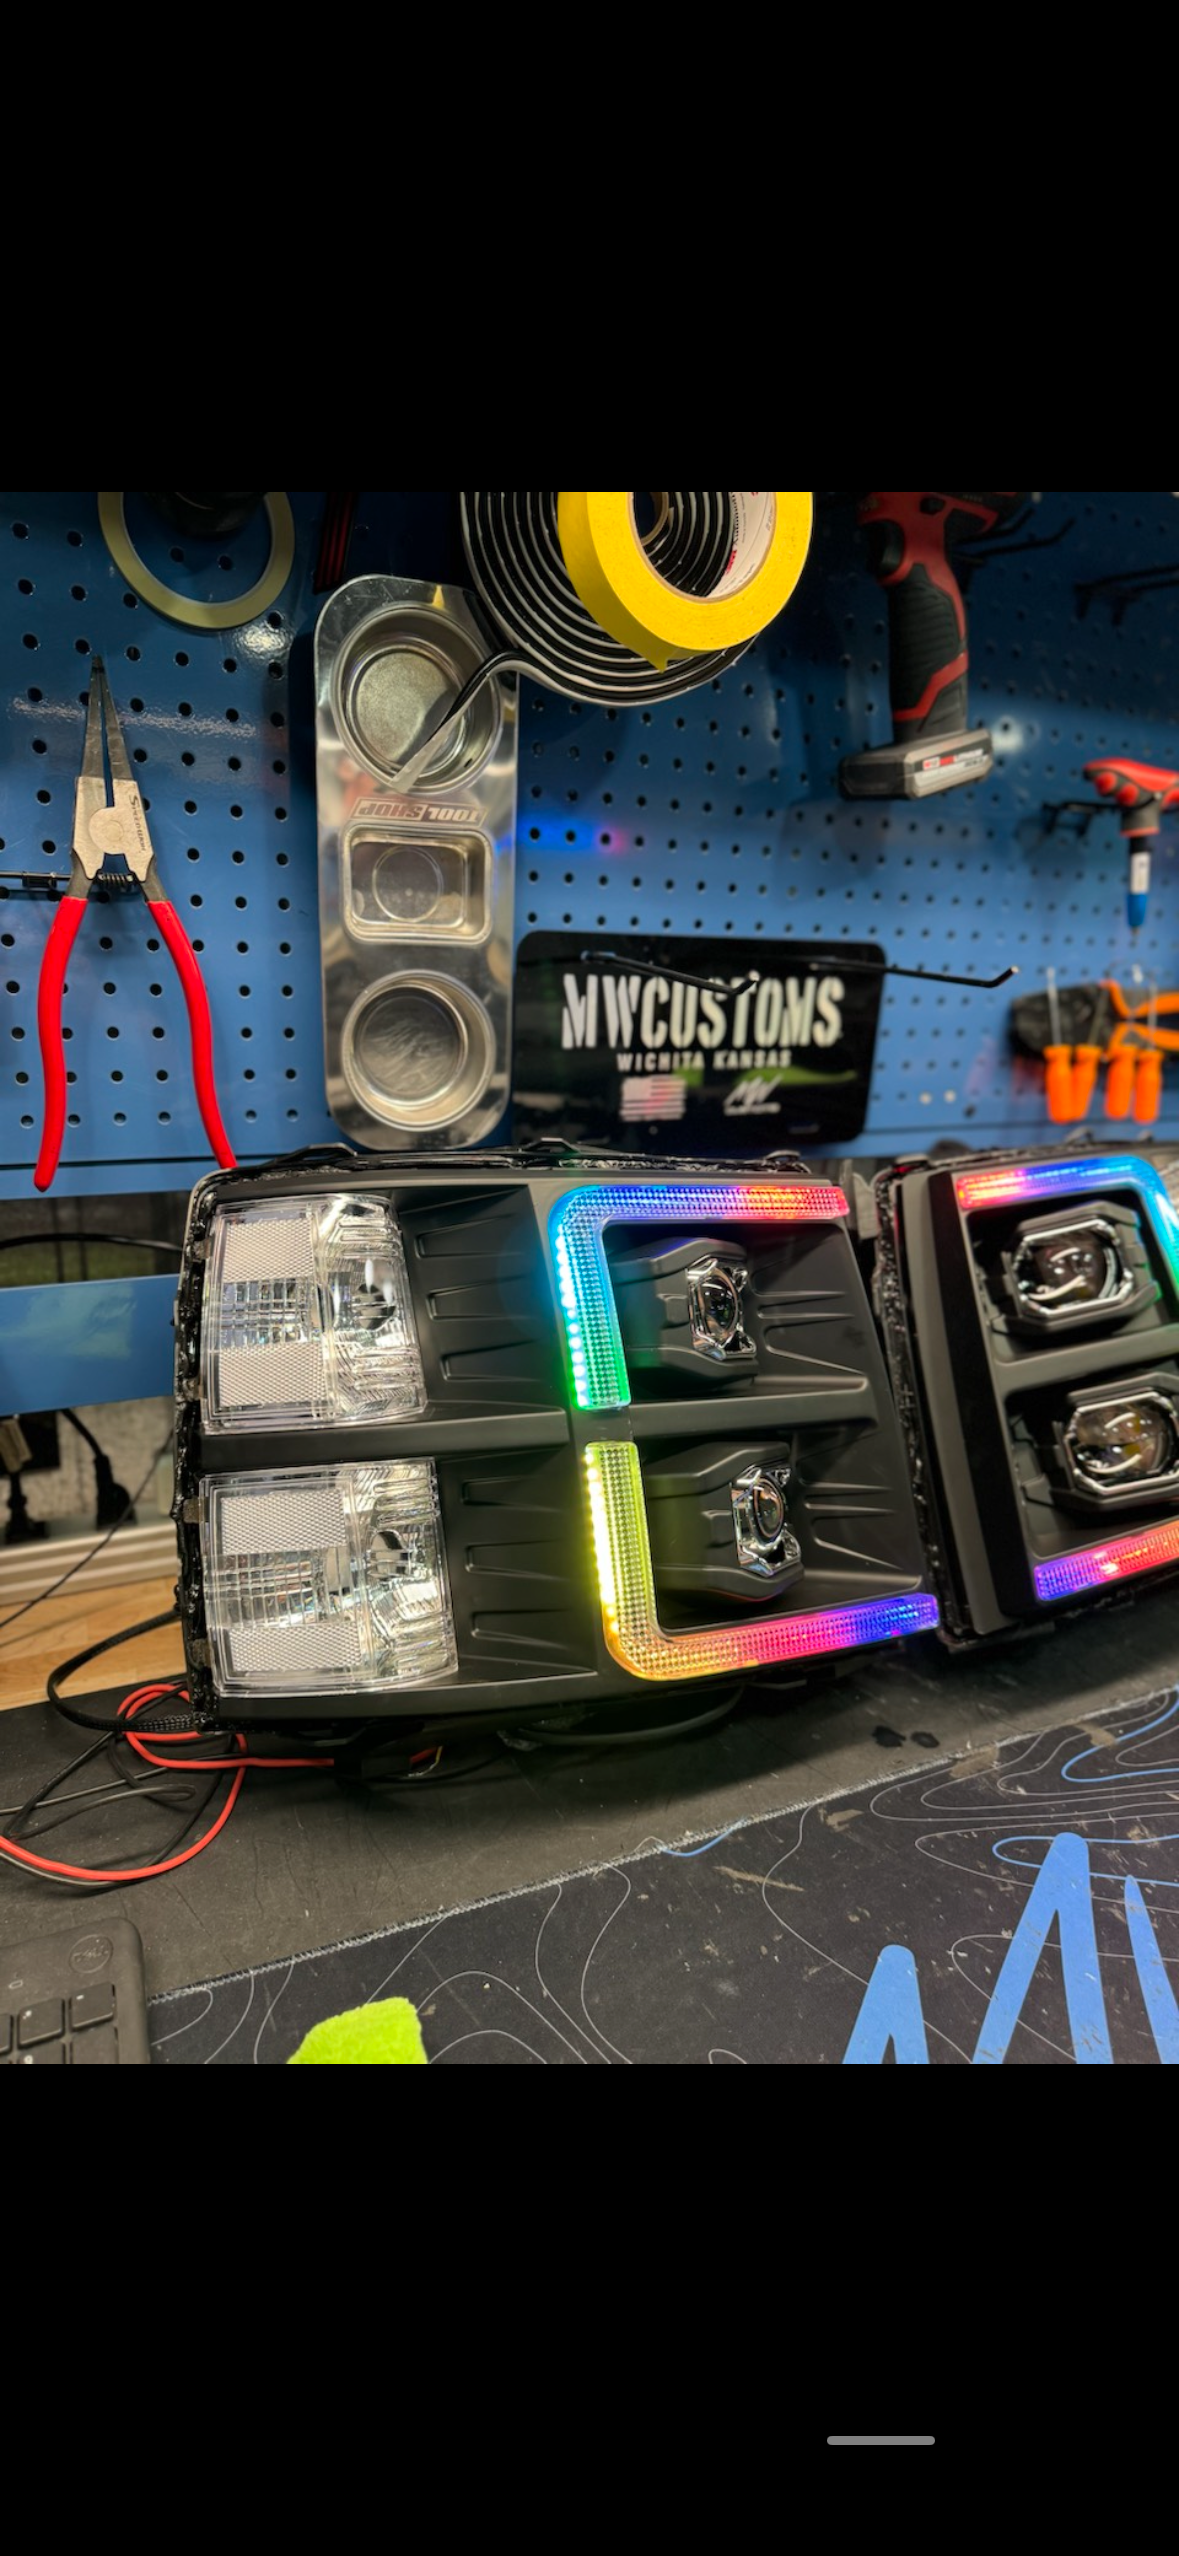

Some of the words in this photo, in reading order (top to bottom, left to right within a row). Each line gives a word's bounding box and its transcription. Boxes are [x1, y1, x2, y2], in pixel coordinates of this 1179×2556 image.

[357, 802, 424, 819] SHOP
[427, 806, 479, 822] TOOL
[561, 973, 845, 1049] MWCUSTOMS
[616, 1053, 705, 1072] WICHITA
[712, 1049, 792, 1070] KANSAS
